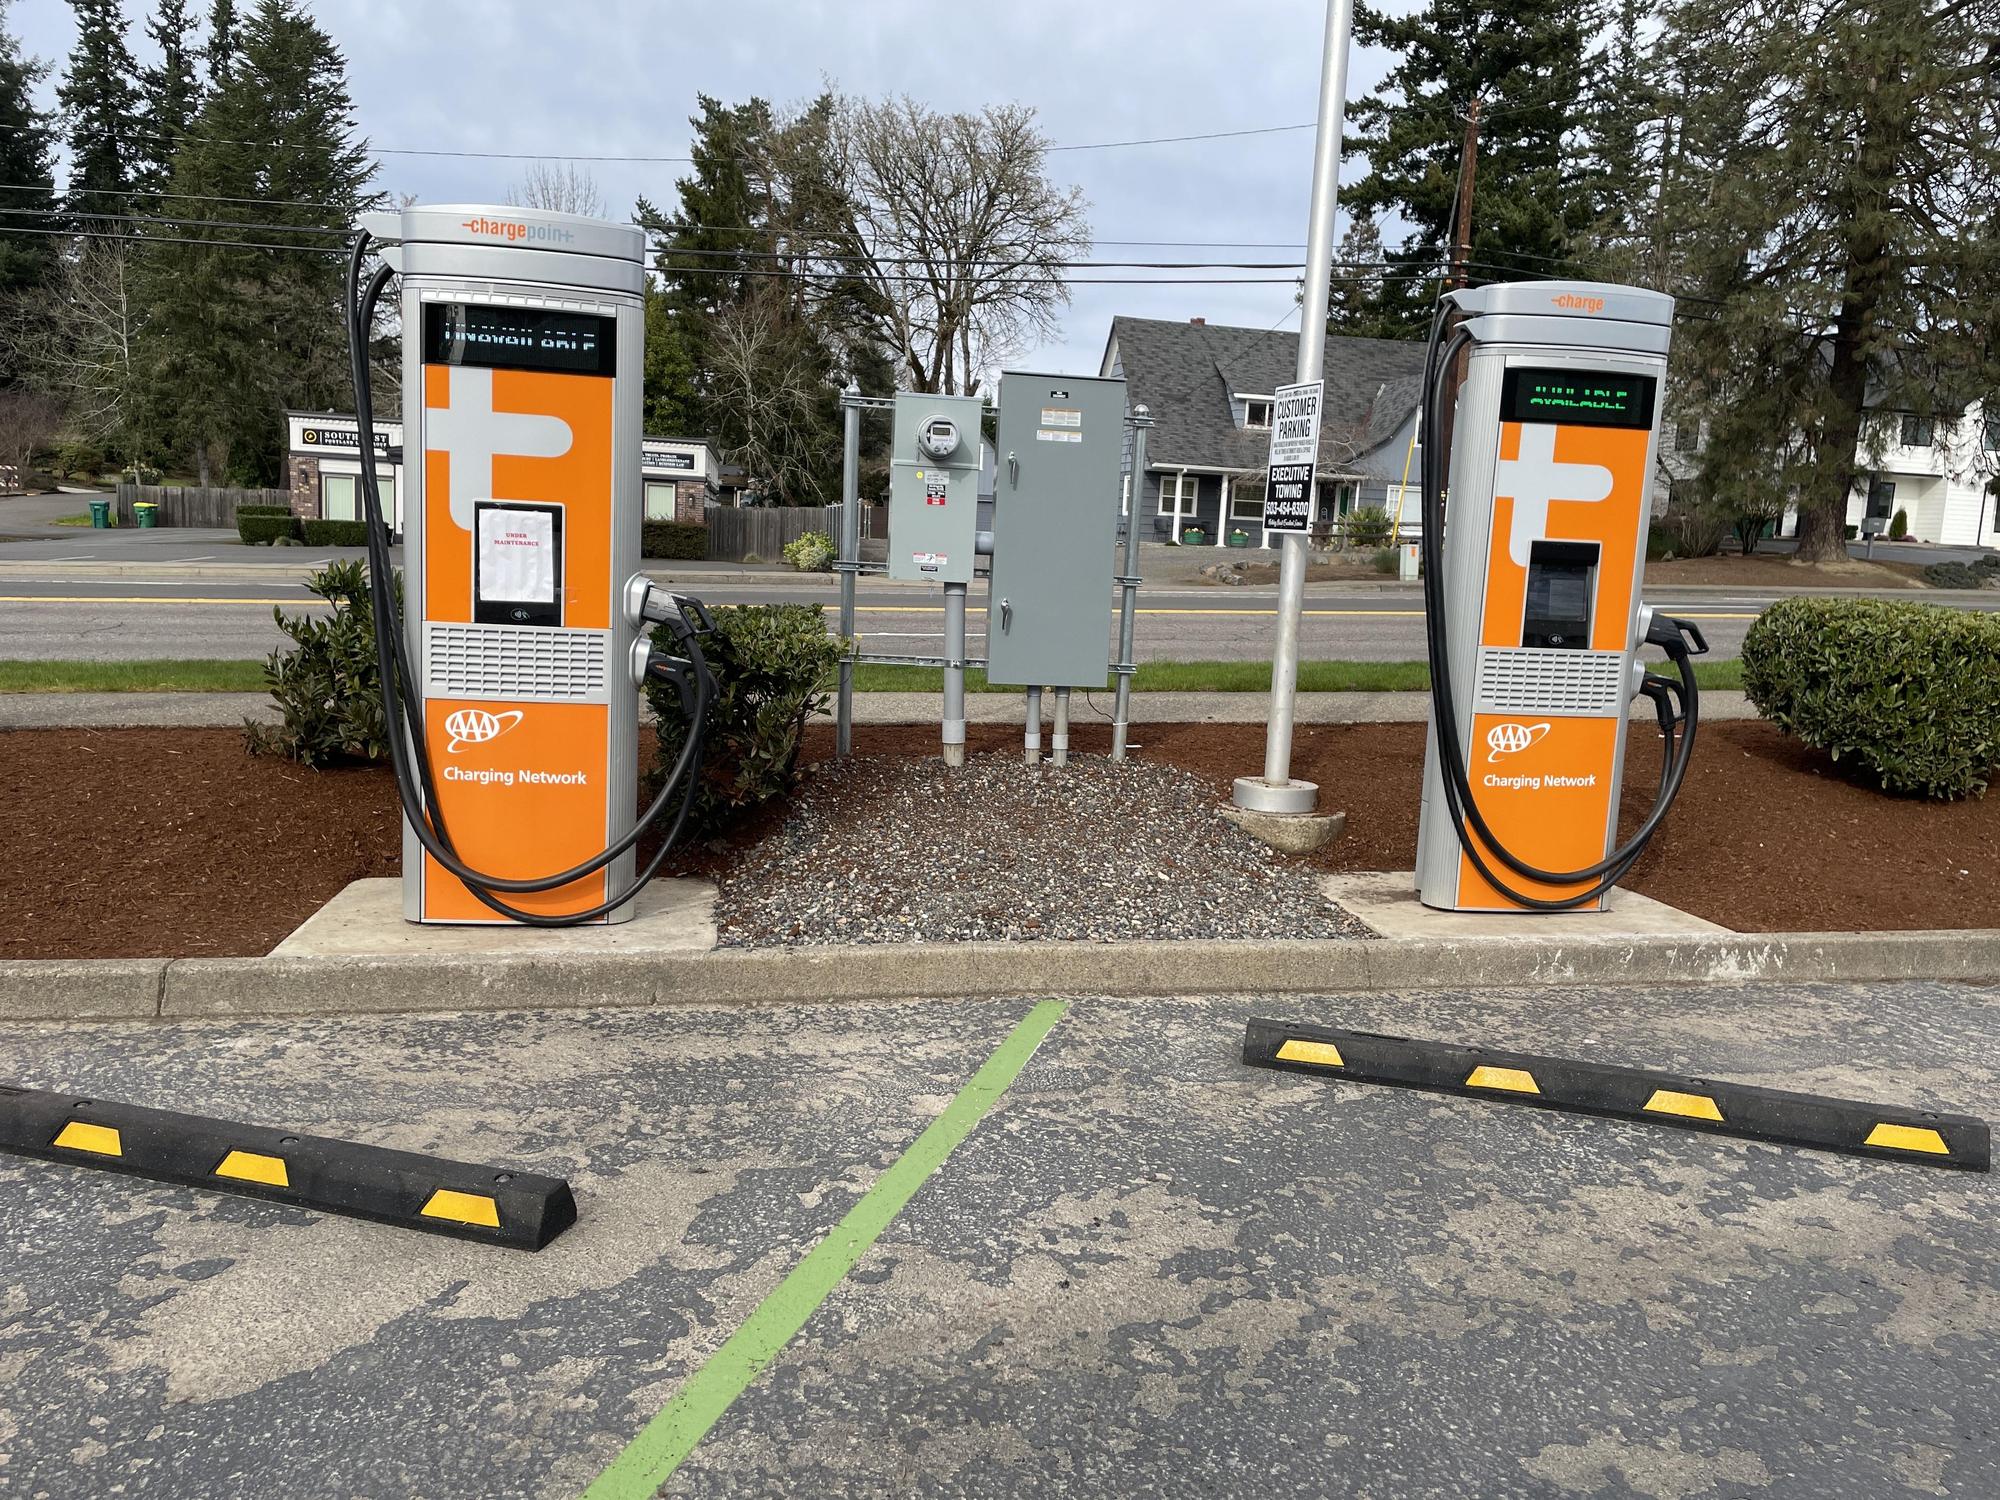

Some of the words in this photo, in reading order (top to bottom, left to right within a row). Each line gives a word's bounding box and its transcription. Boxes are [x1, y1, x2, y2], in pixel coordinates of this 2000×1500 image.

[1552, 294, 1604, 314] charge
[1277, 397, 1317, 419] CUSTOMER
[324, 431, 387, 442] SOUTHST
[1279, 418, 1311, 439] PARKING
[1271, 466, 1310, 481] EXECUTIVE
[1275, 484, 1302, 498] TOWING
[449, 710, 496, 742] AAA
[1490, 724, 1529, 752] AAA
[443, 766, 514, 786] Charging
[518, 769, 587, 785] Network
[1483, 774, 1541, 790] Charging
[1544, 774, 1597, 787] Network
